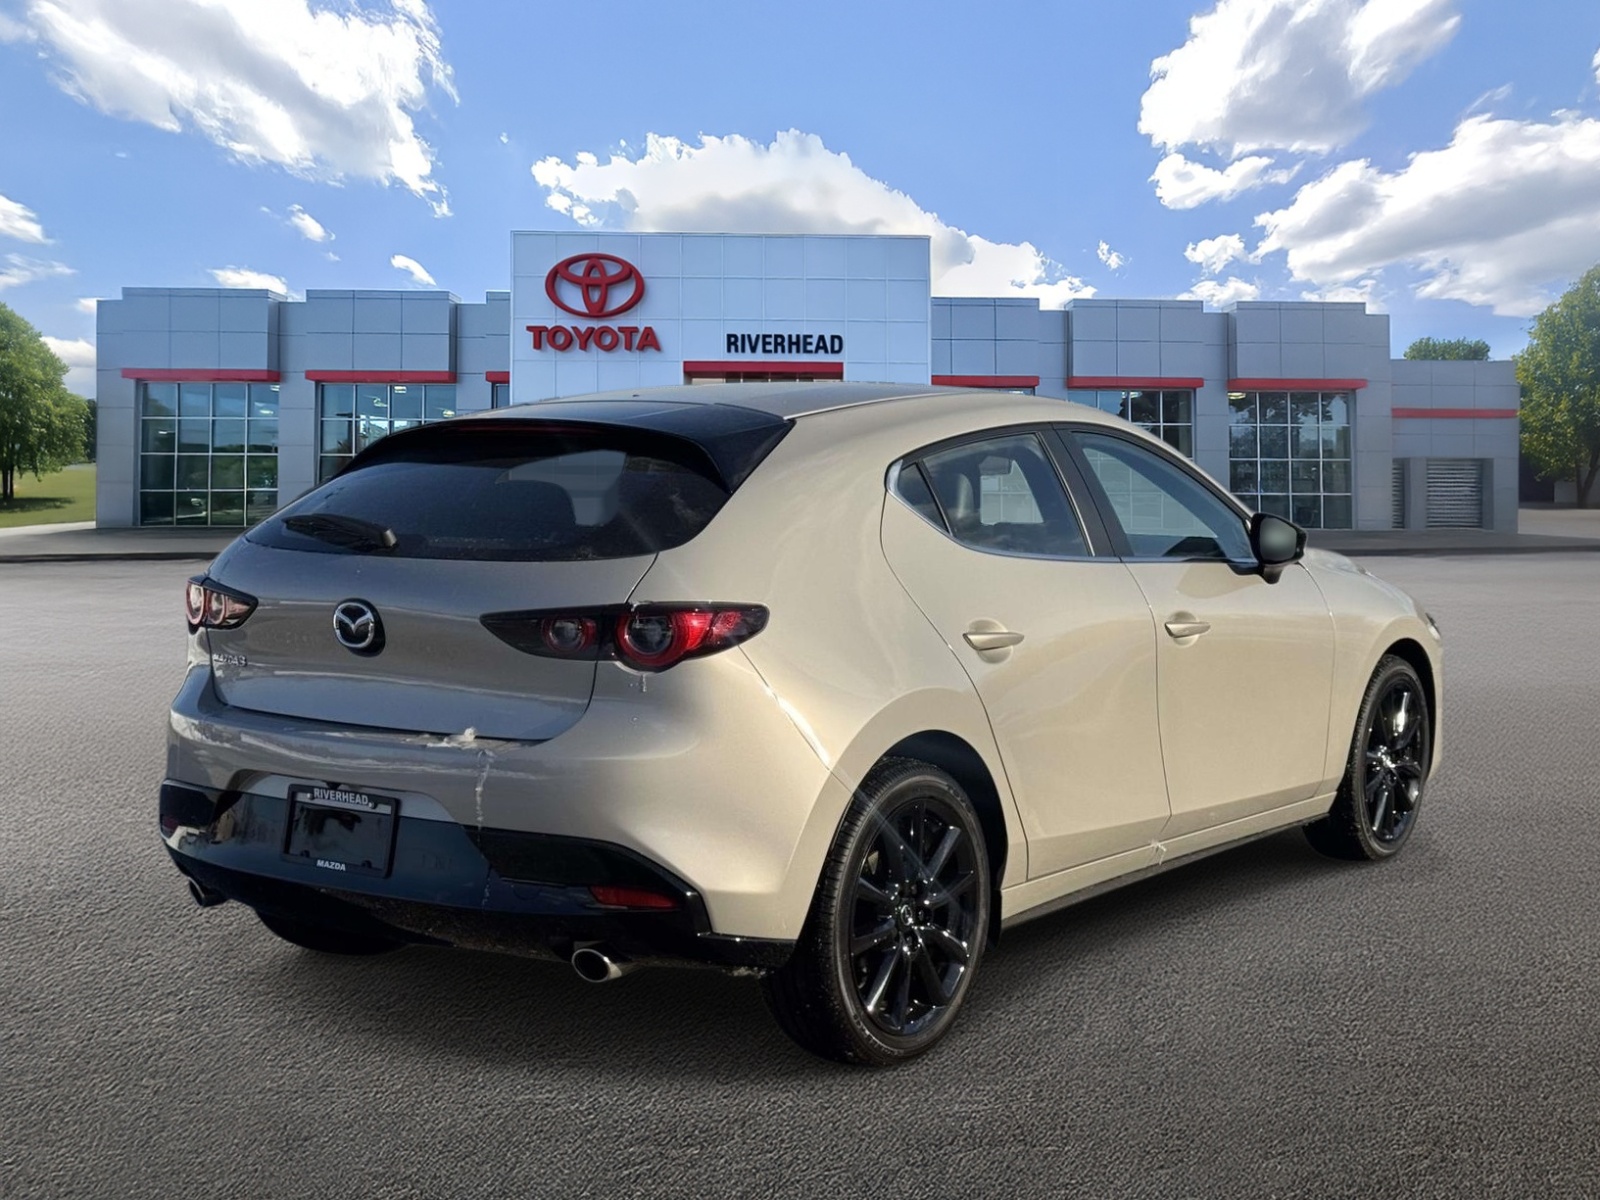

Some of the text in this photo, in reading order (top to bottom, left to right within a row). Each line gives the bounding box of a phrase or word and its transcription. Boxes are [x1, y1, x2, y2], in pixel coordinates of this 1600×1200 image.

[527, 325, 661, 352] TOYOTA
[726, 334, 844, 355] RIVERHEAD
[313, 788, 369, 806] RIVERHEAD
[316, 859, 346, 871] MAZDA
